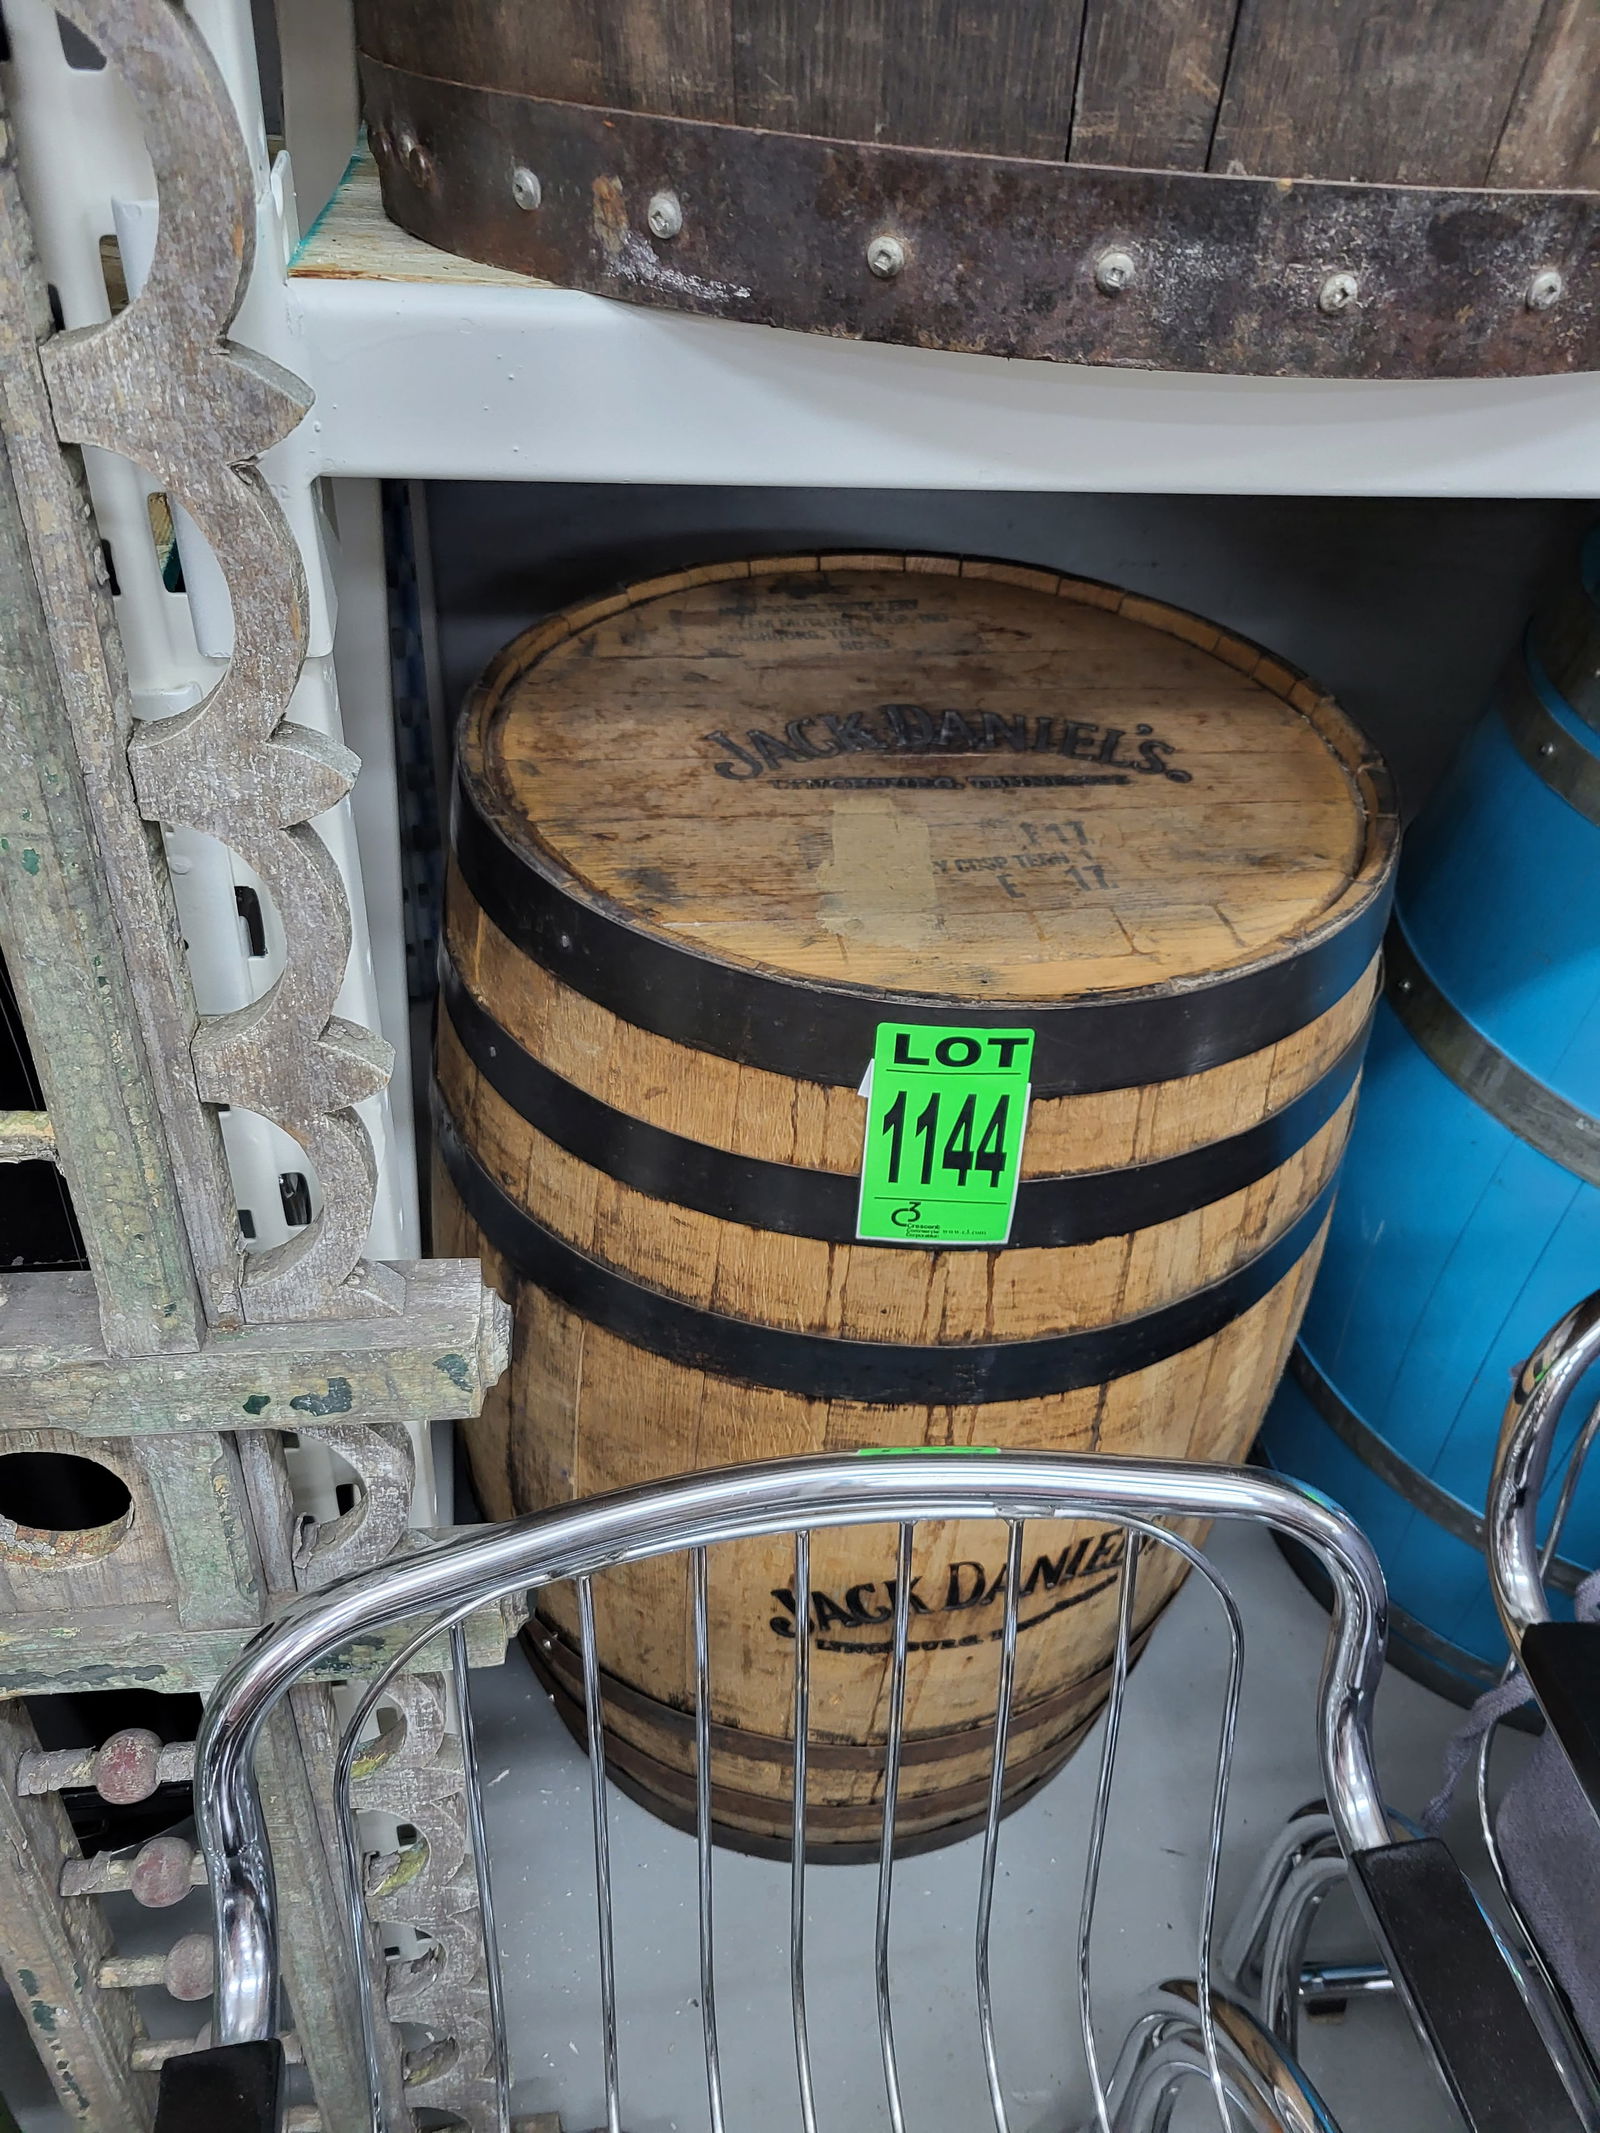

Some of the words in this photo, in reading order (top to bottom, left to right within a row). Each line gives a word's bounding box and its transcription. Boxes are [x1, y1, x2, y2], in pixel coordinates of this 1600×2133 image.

[705, 711, 888, 781] JACK
[894, 1033, 1030, 1068] LOT
[882, 1090, 1010, 1188] 1144
[770, 1575, 932, 1638] JACK
